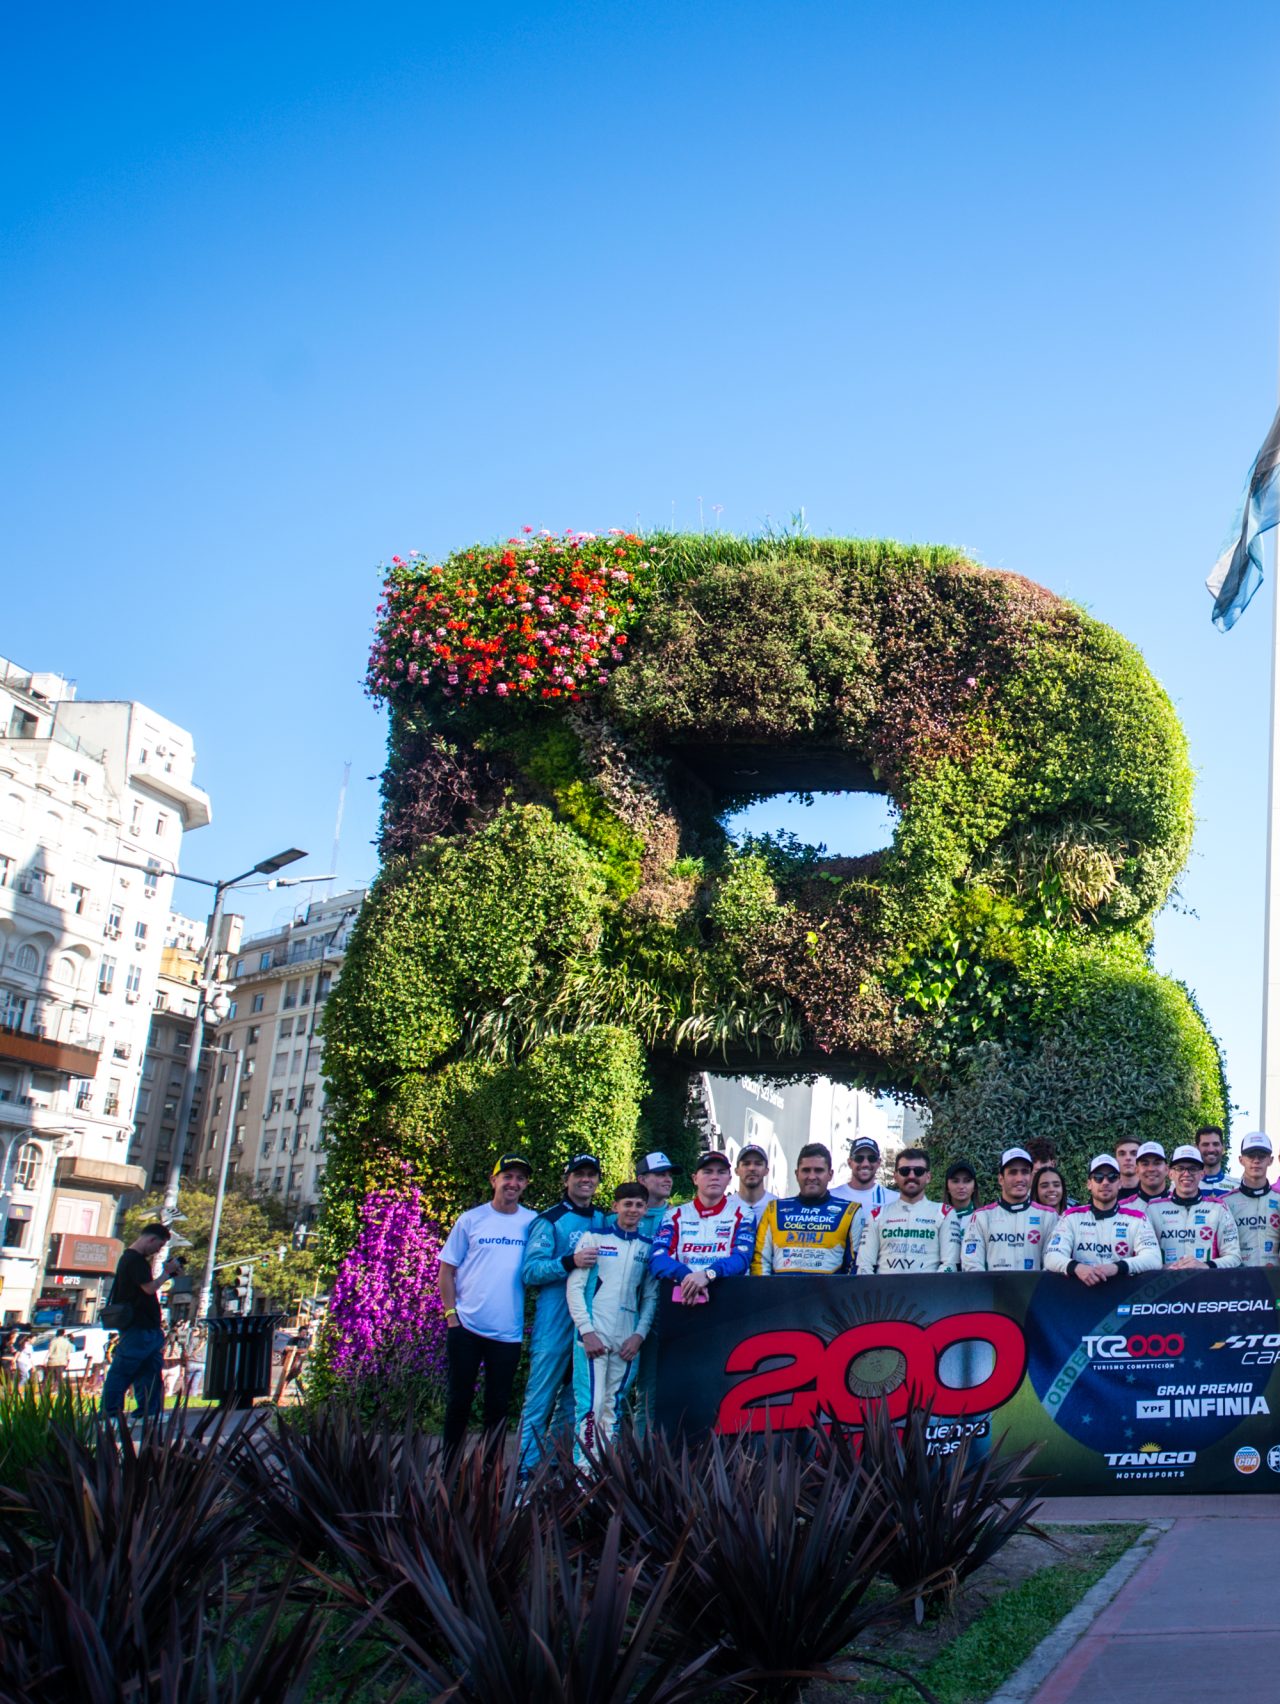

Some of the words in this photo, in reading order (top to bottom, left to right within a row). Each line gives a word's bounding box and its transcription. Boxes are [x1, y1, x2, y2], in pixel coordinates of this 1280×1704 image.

[784, 1214, 835, 1223] VITAMEDIC
[783, 1221, 806, 1230] Colic
[806, 1222, 831, 1231] Calm
[881, 1227, 936, 1240] Cachamate
[988, 1232, 1025, 1243] AXION
[1160, 1229, 1196, 1239] AXION
[1076, 1242, 1112, 1253] AXION
[63, 1275, 81, 1285] GIFTS
[1131, 1301, 1195, 1316] EDICIÓN
[1197, 1299, 1274, 1313] ESPECIAL
[1081, 1333, 1185, 1358] TC2000
[1093, 1363, 1124, 1371] TURISMO
[1126, 1361, 1175, 1370] COMPETICIÓN
[713, 1311, 1028, 1436] 200
[1156, 1384, 1196, 1396] GRAN
[1199, 1382, 1253, 1395] PREMIO
[1142, 1405, 1165, 1413] YPF
[1174, 1396, 1271, 1418] INFINIA
[925, 1422, 986, 1440] uenos
[1103, 1451, 1197, 1466] TANGO
[1115, 1470, 1185, 1479] MOTORSPORTS
